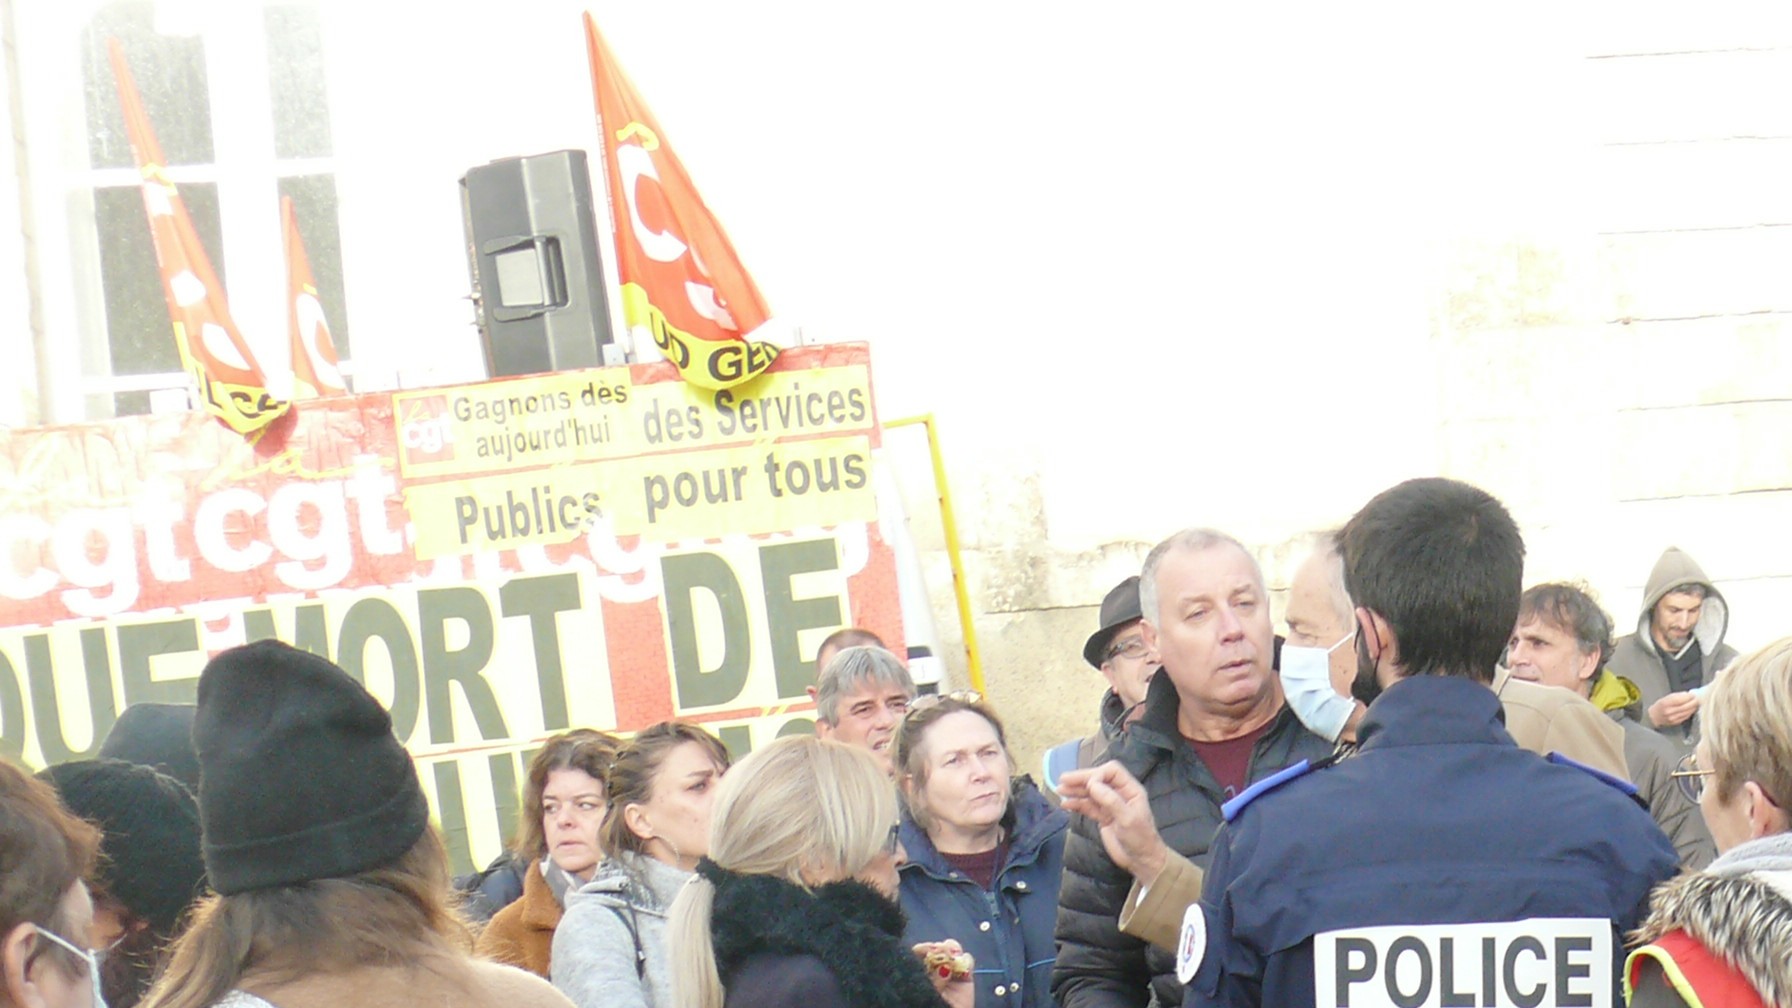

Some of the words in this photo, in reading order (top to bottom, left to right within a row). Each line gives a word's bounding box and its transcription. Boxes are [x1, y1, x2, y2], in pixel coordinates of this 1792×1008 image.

[453, 391, 572, 425] Gagnons
[580, 380, 628, 407] dès
[476, 415, 611, 462] aujourd'hui
[643, 399, 705, 445] des
[714, 382, 866, 437] Services
[0, 470, 191, 617] cgt
[195, 454, 404, 590] cgt
[455, 485, 603, 545] Publics
[643, 465, 748, 524] pour
[764, 452, 867, 498] tous
[660, 537, 844, 712] DE
